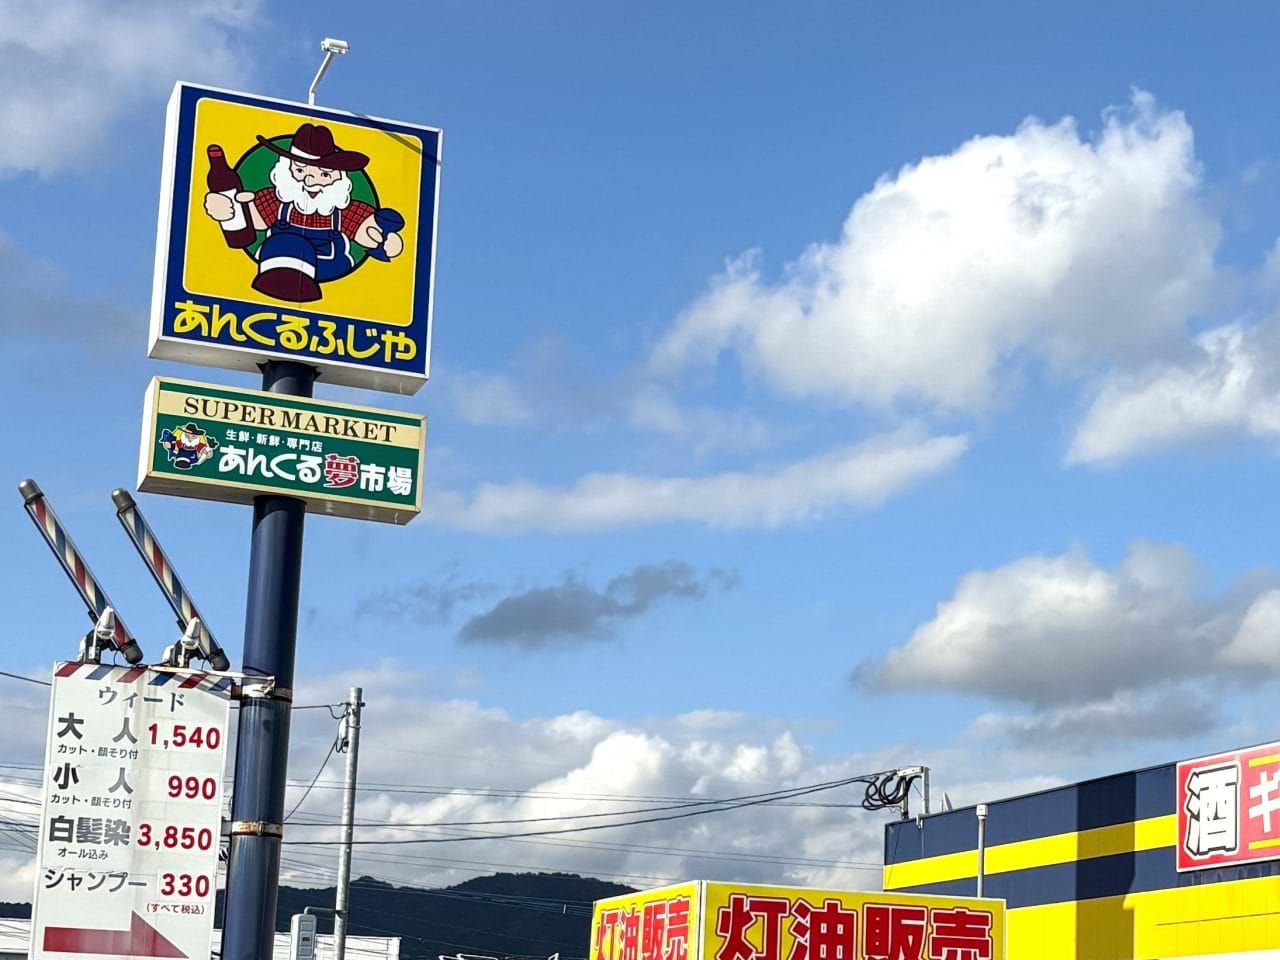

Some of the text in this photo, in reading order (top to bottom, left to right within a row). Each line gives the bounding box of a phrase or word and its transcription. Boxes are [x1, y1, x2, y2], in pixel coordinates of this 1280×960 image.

[174, 300, 416, 363] あんくるふじや
[183, 396, 397, 444] SUPER MARKET
[218, 445, 412, 496] あんくる夢市場
[98, 686, 185, 713] ウィード
[148, 723, 221, 750] 1,540
[57, 744, 139, 760] カット・顔そり付
[50, 793, 132, 809] カット・顔そり付
[168, 775, 217, 800] 990
[1186, 762, 1240, 858] 酒
[49, 815, 131, 847] 白髪染
[137, 823, 212, 851] 3,850
[57, 848, 108, 860] オール込み
[45, 869, 147, 893] シャンプー
[161, 873, 210, 897] 330
